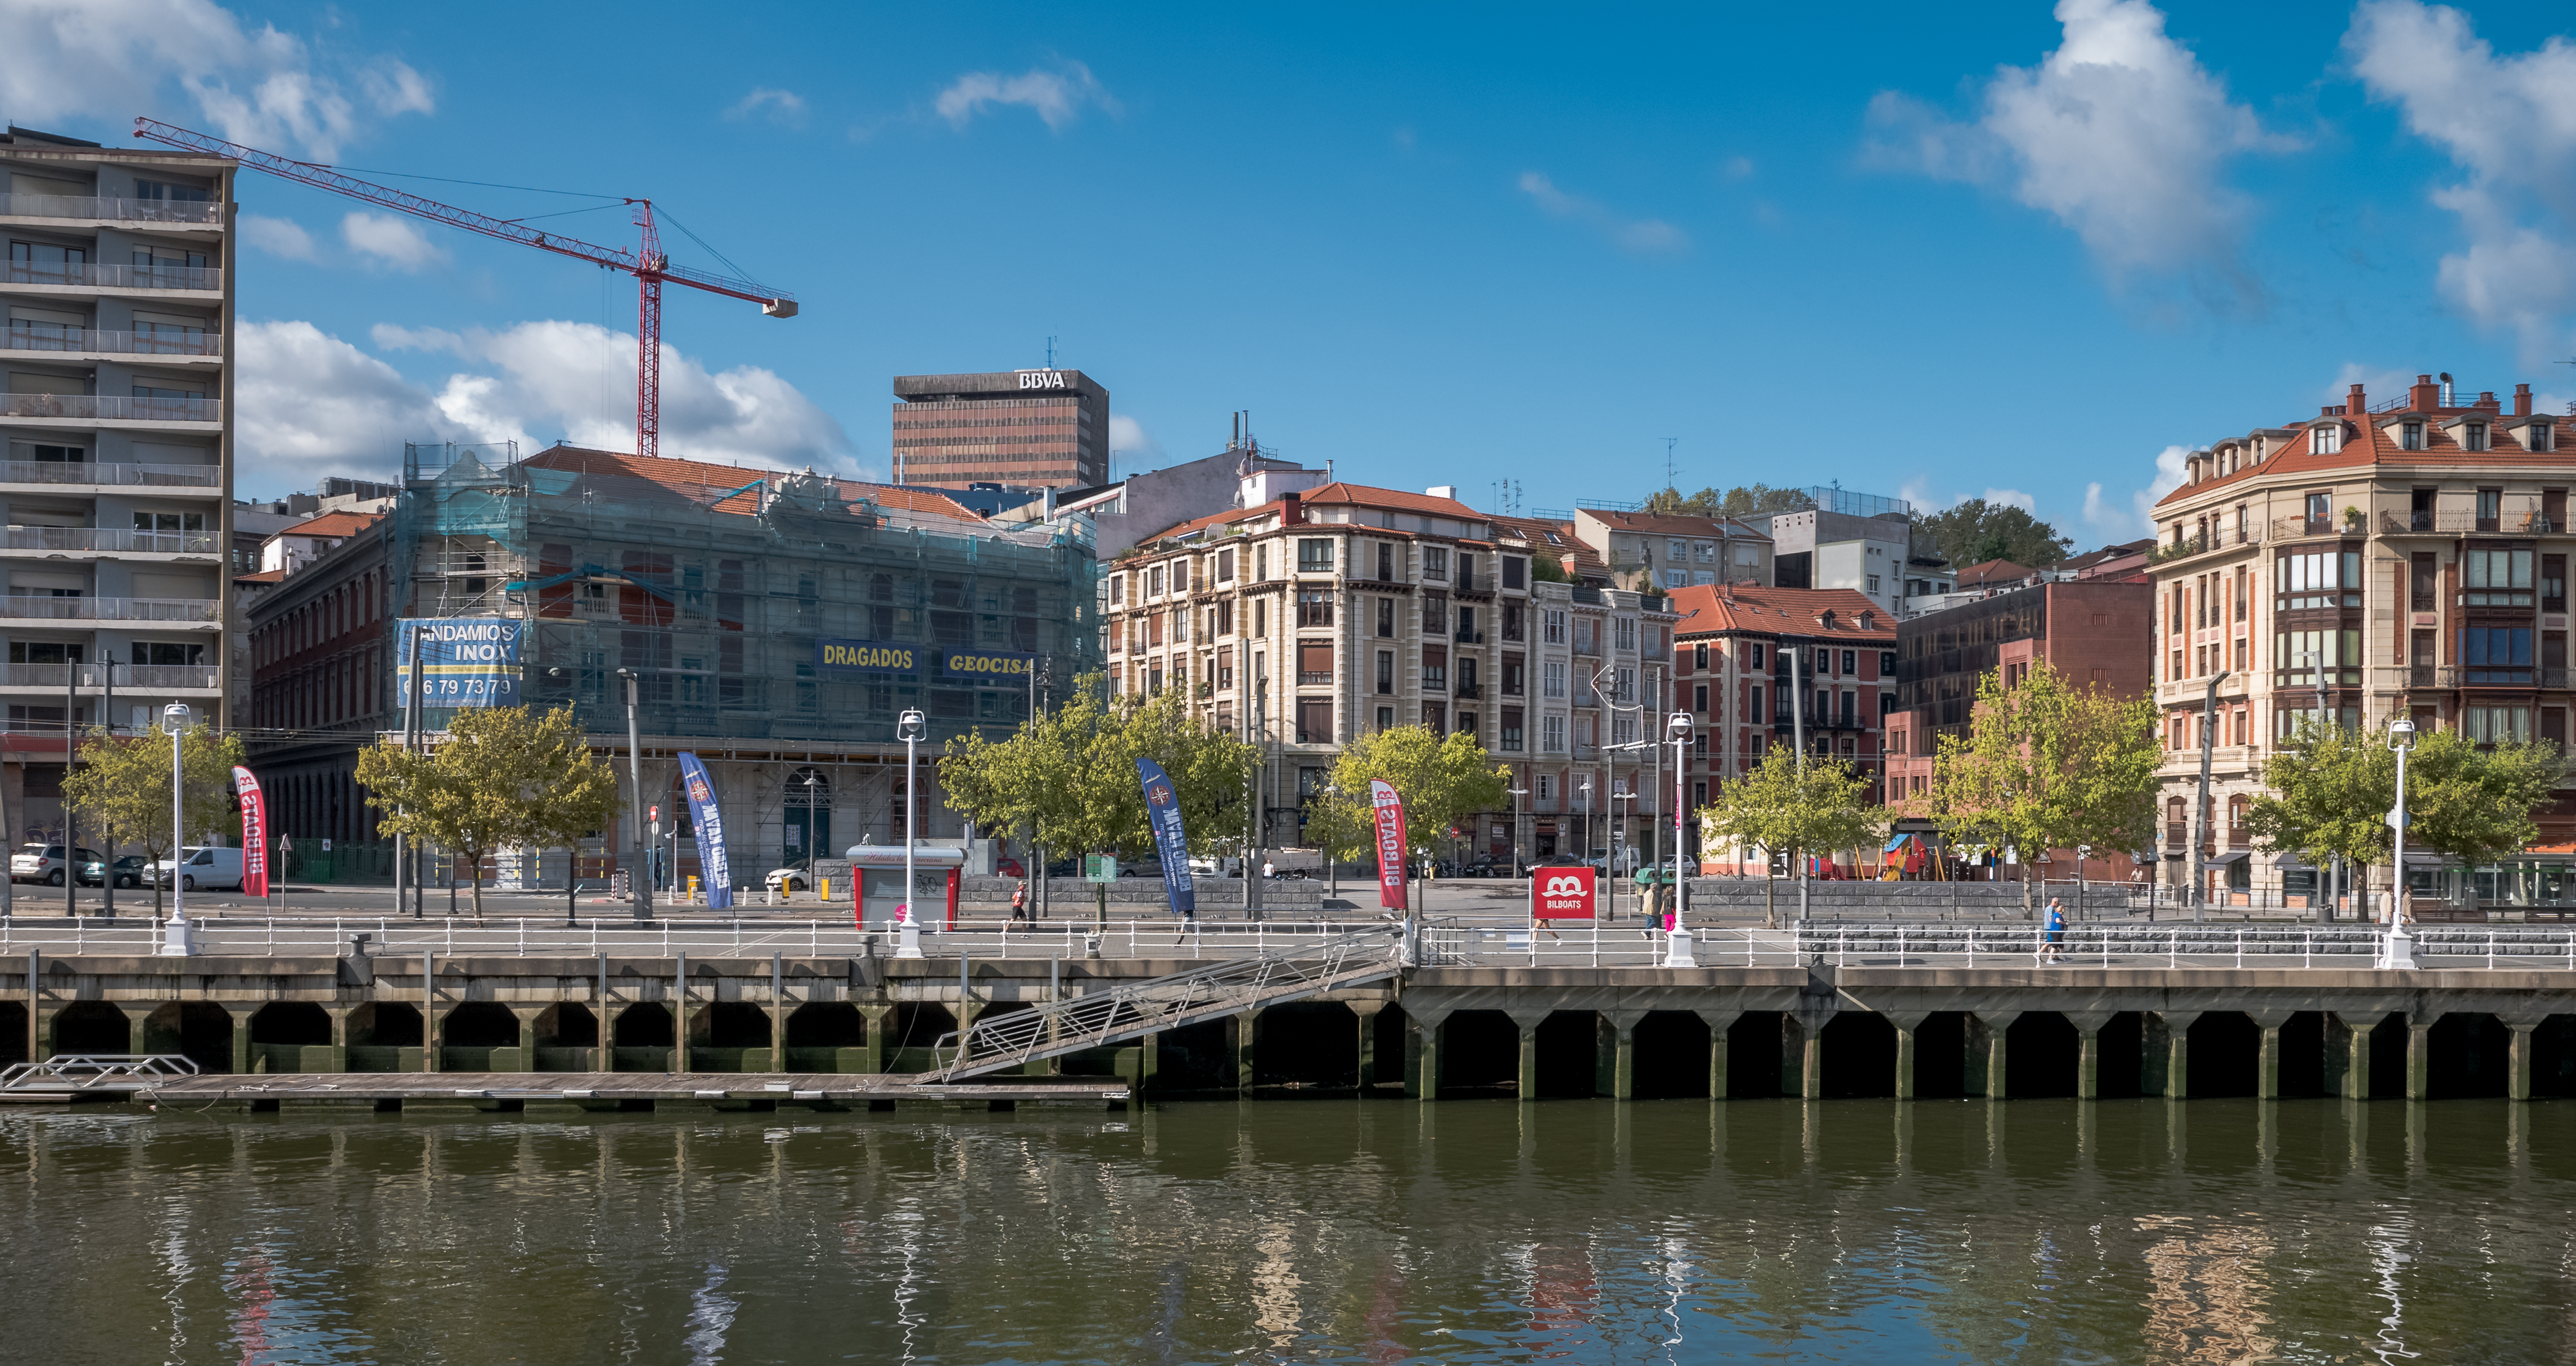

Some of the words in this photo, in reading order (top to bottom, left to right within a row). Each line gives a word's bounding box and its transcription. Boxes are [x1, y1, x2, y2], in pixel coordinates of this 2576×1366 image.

[1019, 372, 1065, 389] BBVA
[421, 625, 515, 642] ANDAMIOS
[455, 644, 512, 661] INOX
[824, 645, 912, 669] DRAGADOS
[404, 679, 433, 695] 66
[439, 679, 458, 695] 79
[464, 679, 484, 695] 73
[489, 679, 511, 695] 79
[864, 851, 895, 862] Helados
[896, 853, 904, 862] la
[914, 853, 943, 863] eneciana
[1547, 900, 1581, 908] BILBOATS
